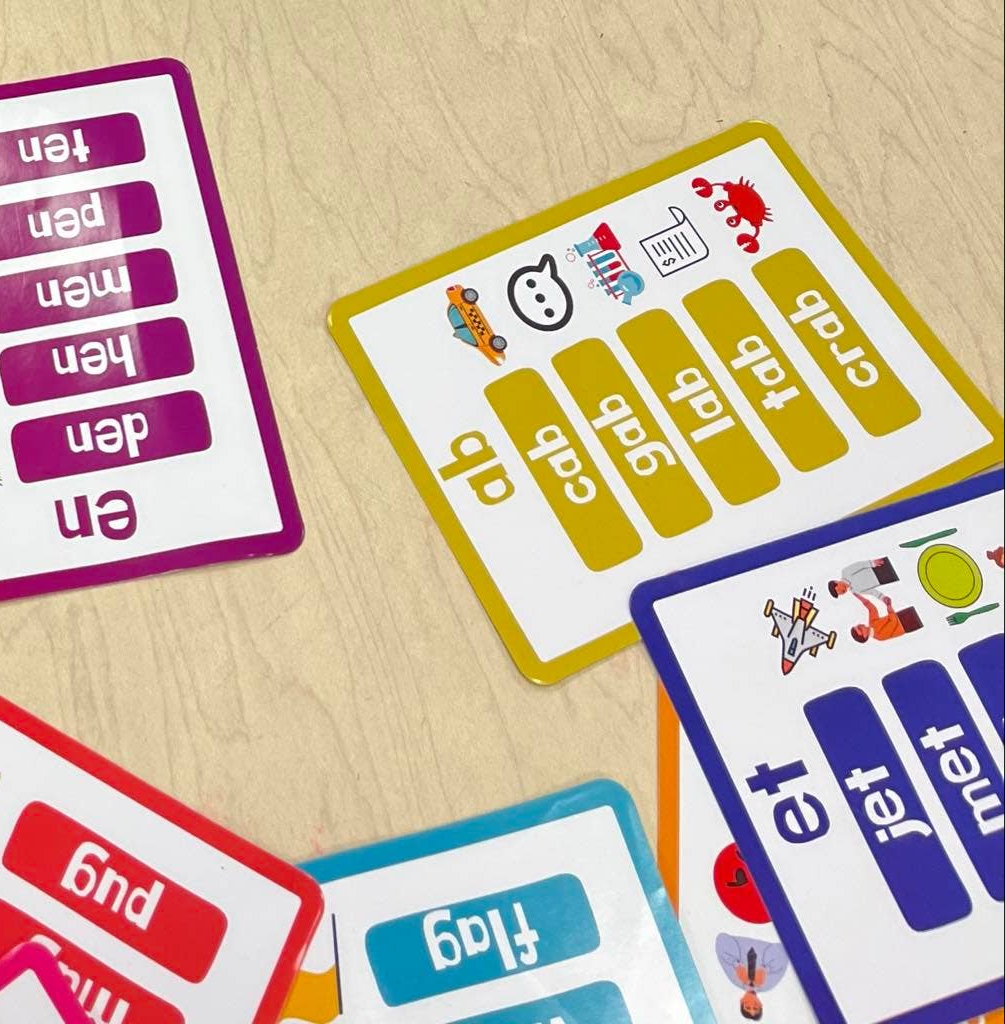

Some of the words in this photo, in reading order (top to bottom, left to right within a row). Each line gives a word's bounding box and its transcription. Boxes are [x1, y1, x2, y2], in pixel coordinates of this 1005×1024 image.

[17, 126, 90, 166] ten
[27, 191, 106, 243] pen
[35, 264, 131, 310] men
[51, 333, 135, 378] hen
[733, 333, 800, 412] tab
[790, 289, 879, 388] crab
[65, 410, 149, 456] den
[593, 392, 676, 479] gab
[674, 364, 735, 443] lab
[436, 429, 516, 506] ab
[532, 422, 597, 505] cab
[53, 489, 137, 544] en
[742, 757, 830, 846] et
[843, 763, 930, 846] jet
[917, 721, 1005, 838] met
[59, 840, 164, 931] pug
[421, 899, 538, 975] flag
